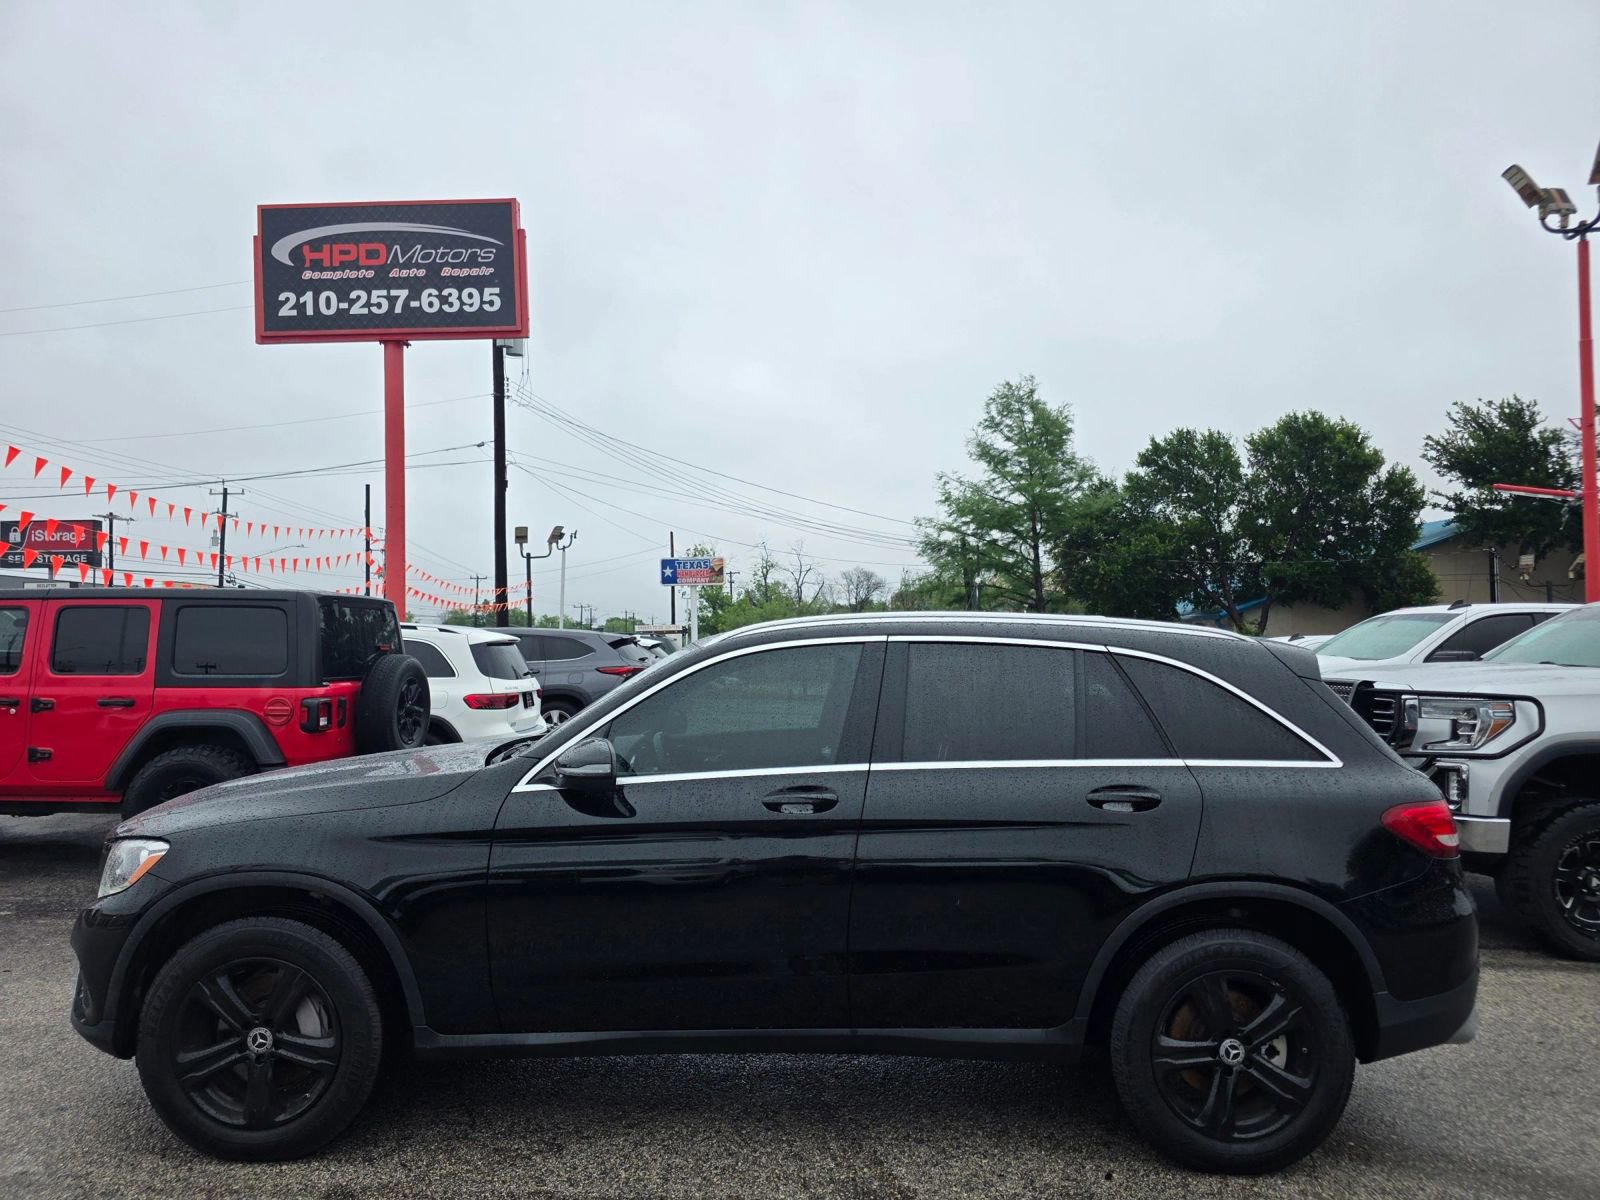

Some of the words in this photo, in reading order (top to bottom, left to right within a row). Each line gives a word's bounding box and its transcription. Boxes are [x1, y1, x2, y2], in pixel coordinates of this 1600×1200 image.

[302, 269, 375, 280] Complete
[389, 268, 426, 277] Auto
[441, 266, 495, 277] Repair
[278, 287, 501, 316] 210-257-6395
[676, 561, 709, 570] TEXAS
